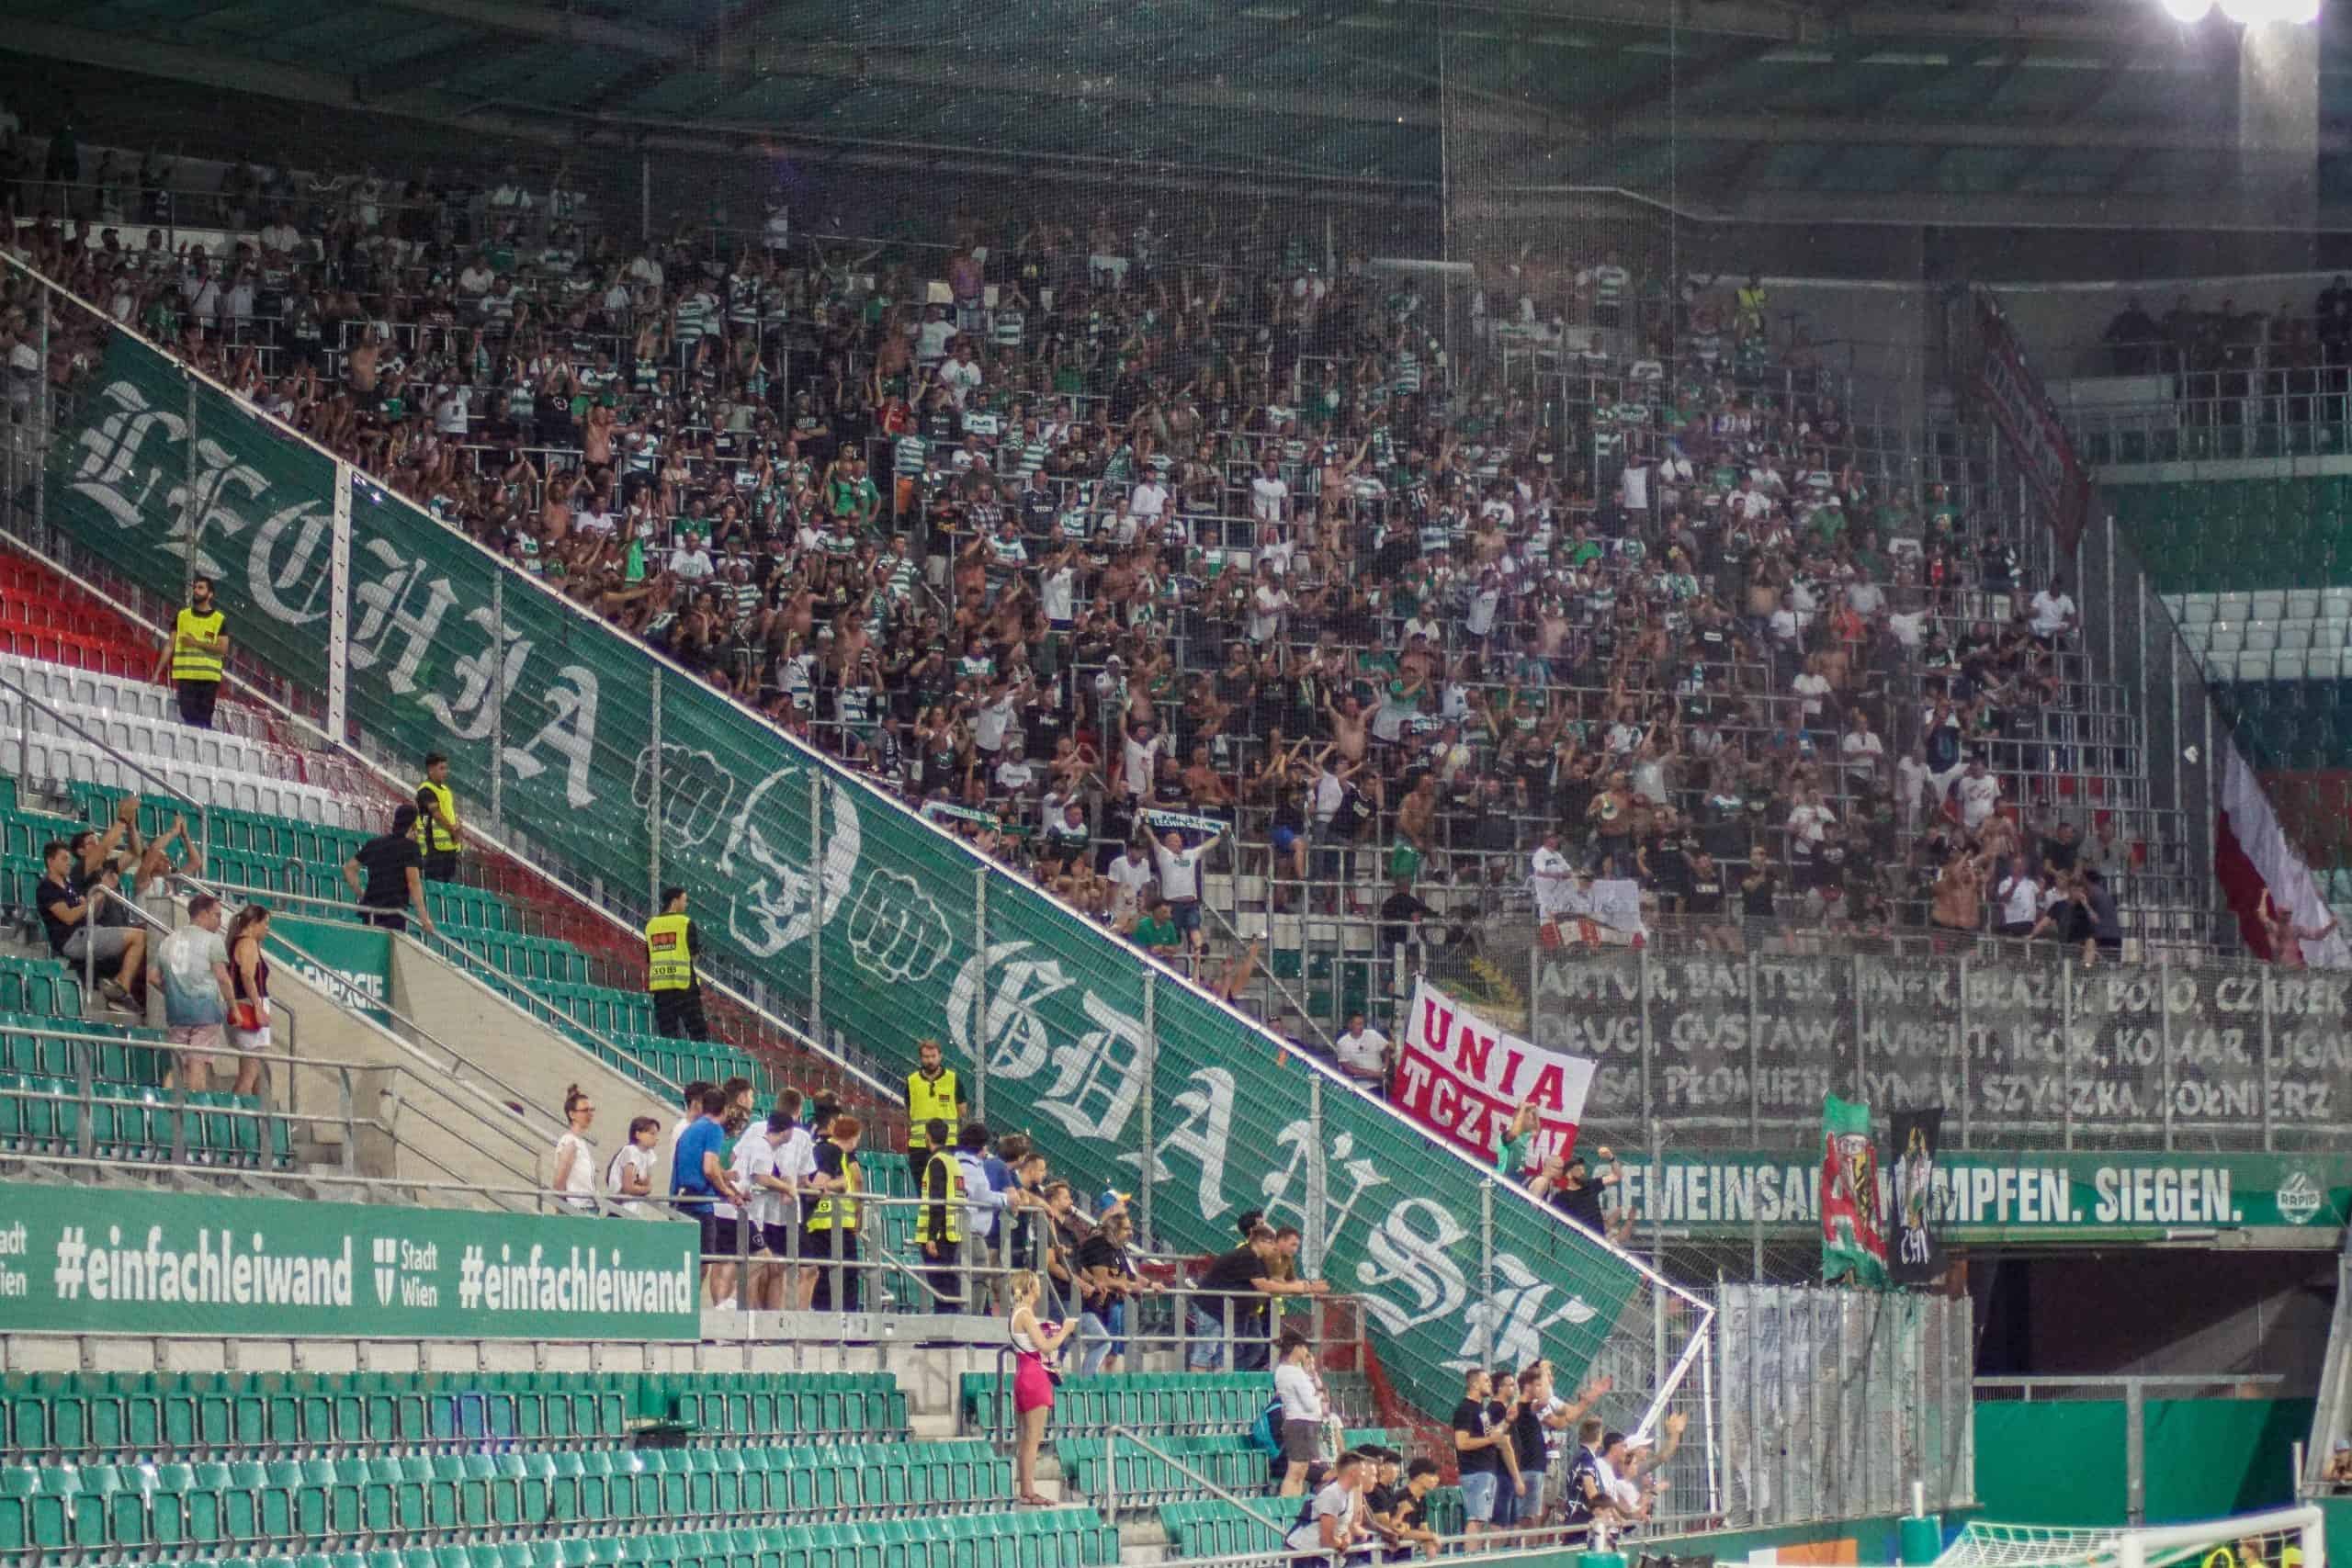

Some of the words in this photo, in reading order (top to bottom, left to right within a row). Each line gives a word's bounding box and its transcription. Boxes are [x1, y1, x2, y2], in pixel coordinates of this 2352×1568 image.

[1424, 997, 1565, 1113] UNIA
[1592, 1164, 1822, 1221] GEMEINSA
[2095, 1167, 2242, 1223] SIEGEN.
[54, 1225, 352, 1307] #einfachleiwand
[401, 1239, 438, 1271] Stadt
[459, 1243, 692, 1314] #einfachleiwand
[401, 1275, 438, 1308] Wien
